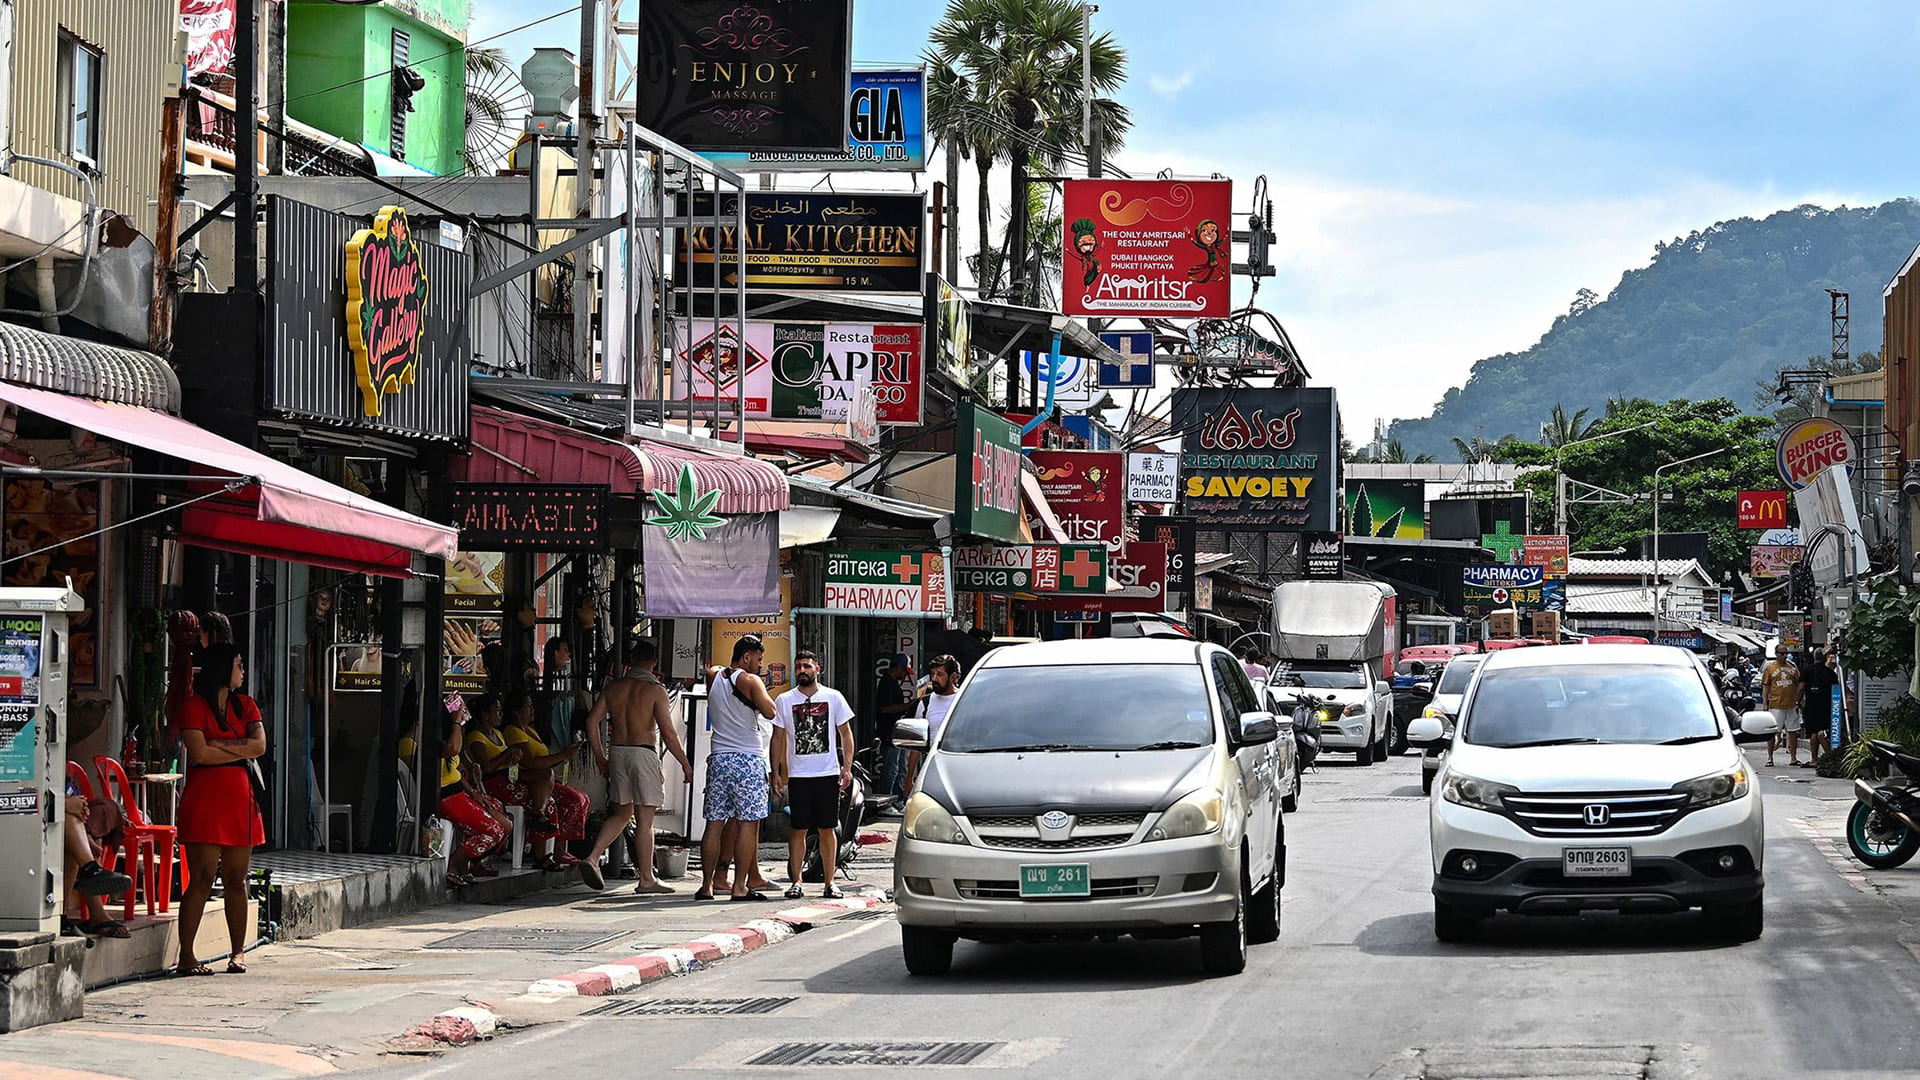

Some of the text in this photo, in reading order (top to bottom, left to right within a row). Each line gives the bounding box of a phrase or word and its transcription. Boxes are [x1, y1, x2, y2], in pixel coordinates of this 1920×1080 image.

[690, 62, 799, 88] ENJOY
[711, 90, 777, 100] MASSAGE
[849, 87, 905, 142] GLA
[857, 145, 881, 162] CO.,
[884, 145, 909, 161] LTD.
[749, 200, 877, 222] مطعم الخليج
[784, 223, 917, 254] KITCHEN
[1119, 231, 1140, 239] ONLY
[1142, 231, 1185, 239] AMRITSARI
[363, 243, 418, 314] Magic
[845, 277, 856, 285] 15
[1096, 273, 1192, 299] Amritsr
[369, 298, 419, 381] Gallery
[775, 328, 910, 344] Italian Restaurant
[771, 342, 911, 387] CAPRI
[1786, 430, 1843, 464] BURGER
[1184, 455, 1318, 470] RESTAURANT
[1790, 442, 1847, 482] KING
[1129, 473, 1175, 487] PHARMACY
[1185, 476, 1314, 498] SAVOEY
[1132, 487, 1172, 499] аптека
[956, 548, 1028, 567] ARMACY
[828, 560, 887, 576] аптека
[1034, 548, 1058, 588] 药店
[1463, 567, 1539, 580] PHARMACY
[825, 587, 918, 611] PHARMACY
[1509, 589, 1541, 603] 藥房
[6, 620, 40, 632] MOON
[1654, 637, 1697, 646] XCHANGE
[354, 678, 371, 686] Hair
[1831, 699, 1841, 742] HAZARD ZONE
[10, 796, 36, 806] CREW
[1596, 851, 1626, 863] 2603
[1058, 868, 1081, 882] 261
